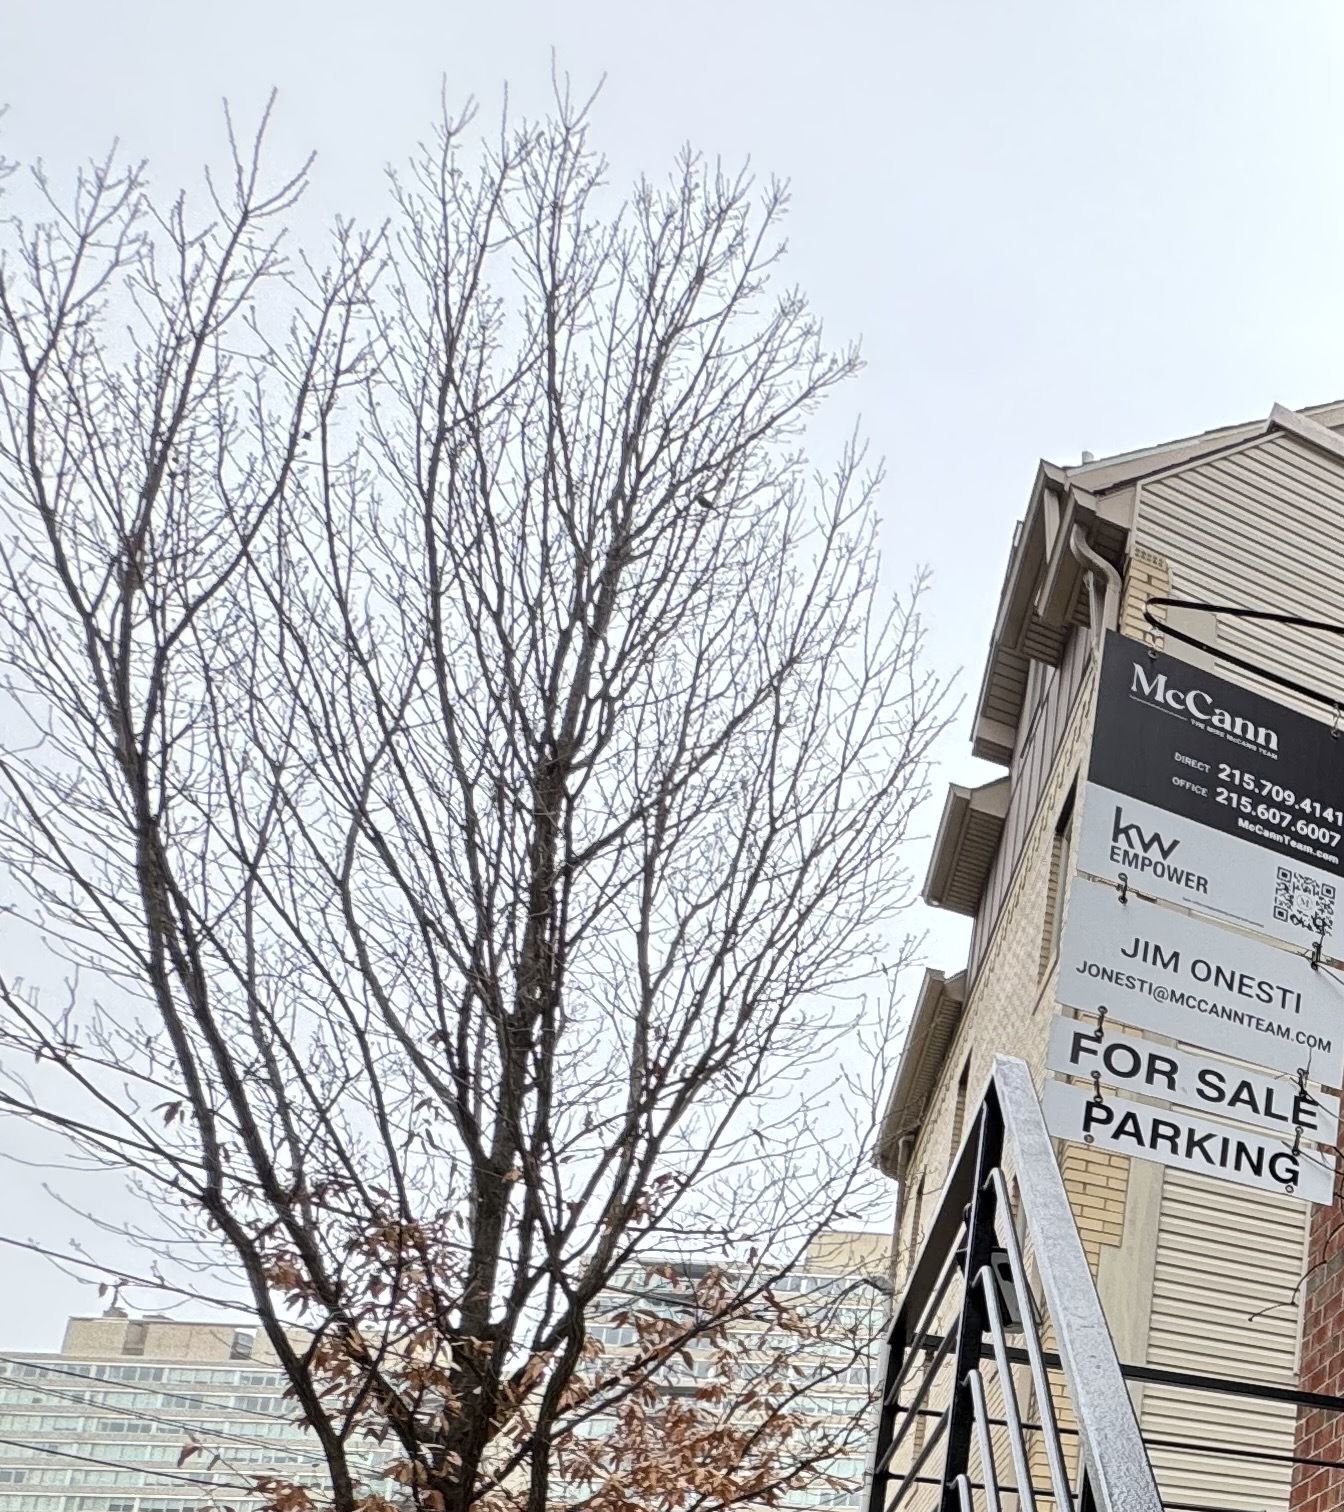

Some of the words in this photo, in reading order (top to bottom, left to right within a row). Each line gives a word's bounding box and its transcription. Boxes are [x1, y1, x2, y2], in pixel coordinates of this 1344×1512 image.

[1130, 663, 1278, 751] McCann
[1172, 776, 1208, 798] OFFICE
[1215, 787, 1342, 848] 215.607.6007
[1174, 752, 1211, 773] DIRECT
[1217, 763, 1343, 827] 215.709.4141
[1109, 845, 1209, 895] EMPOWER
[1238, 817, 1339, 865] McCannTeam.com
[1076, 960, 1332, 1054] JONESTI@MCCANNTEAM.COM
[1121, 937, 1181, 973] JIM
[1190, 959, 1302, 1014] ONESTI
[1069, 1031, 1179, 1092] FOR
[1195, 1069, 1319, 1131] SALE
[1082, 1100, 1301, 1187] PARKING
